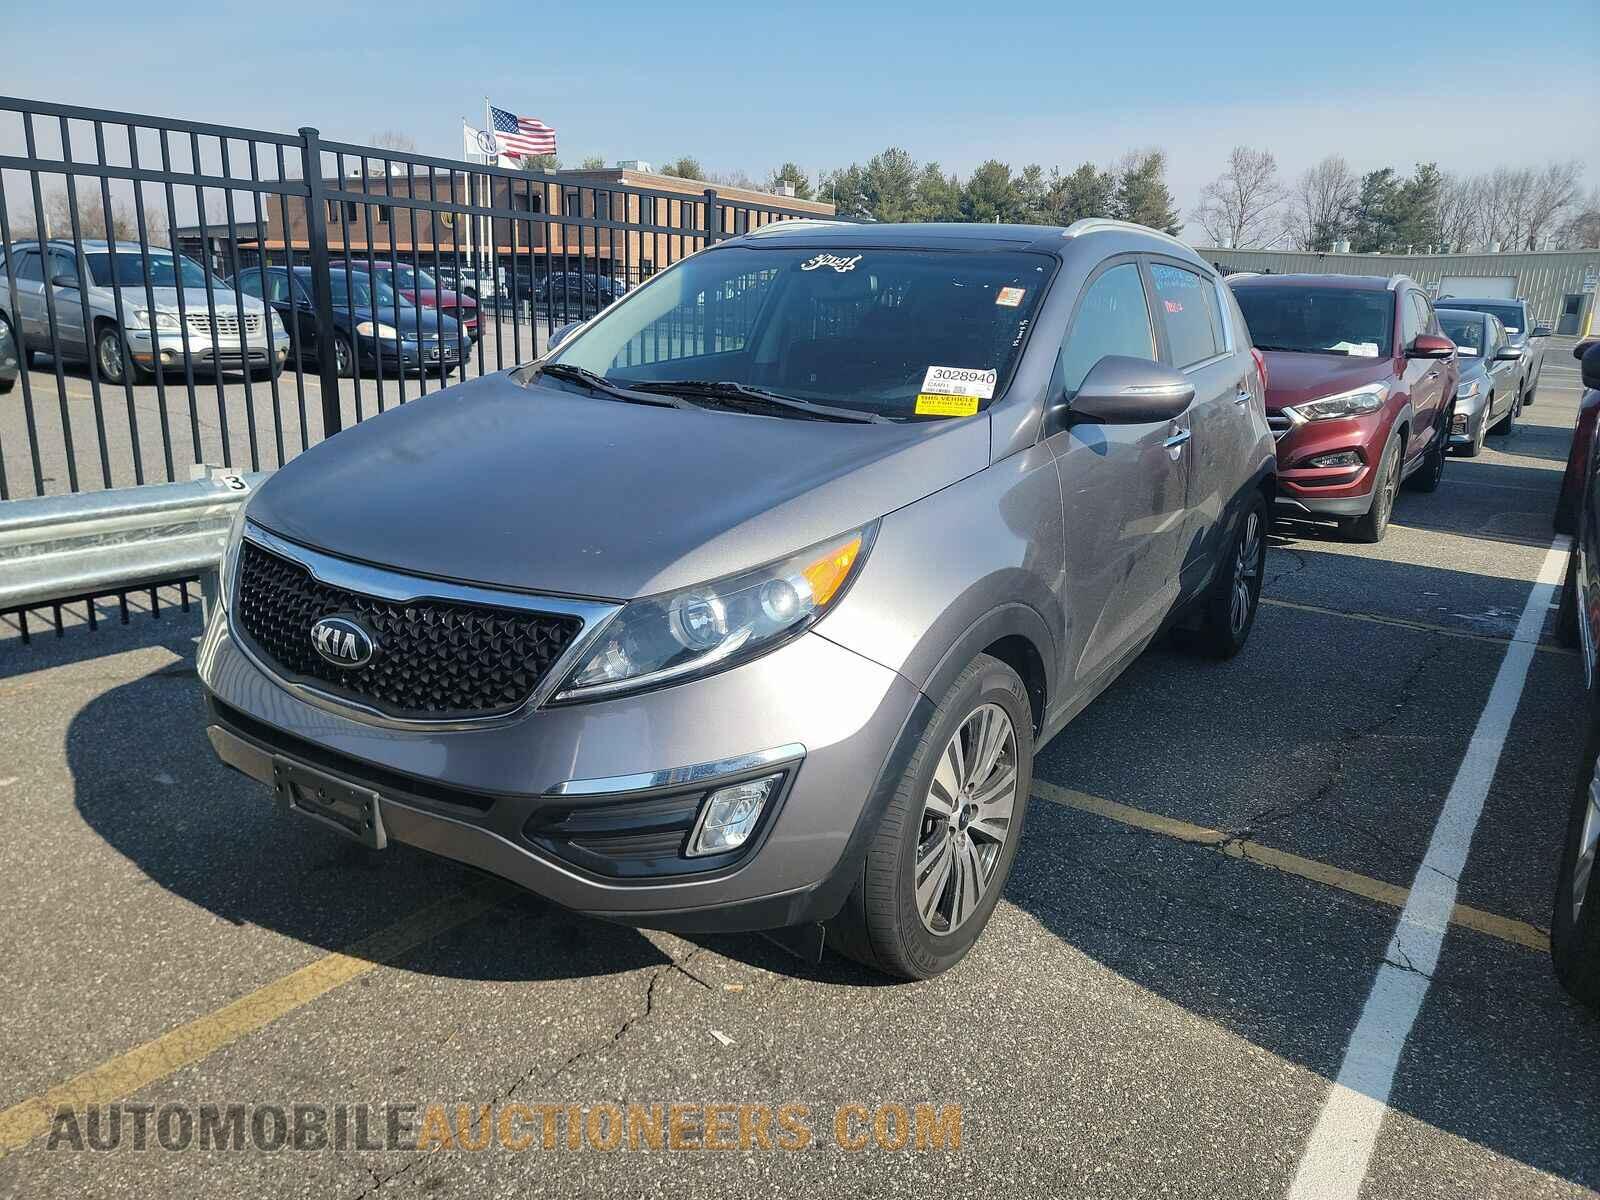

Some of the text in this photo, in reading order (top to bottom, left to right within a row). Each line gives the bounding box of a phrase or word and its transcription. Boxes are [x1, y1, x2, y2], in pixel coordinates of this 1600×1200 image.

[933, 369, 995, 384] 3028940
[225, 476, 246, 490] 3
[318, 625, 358, 660] KIA
